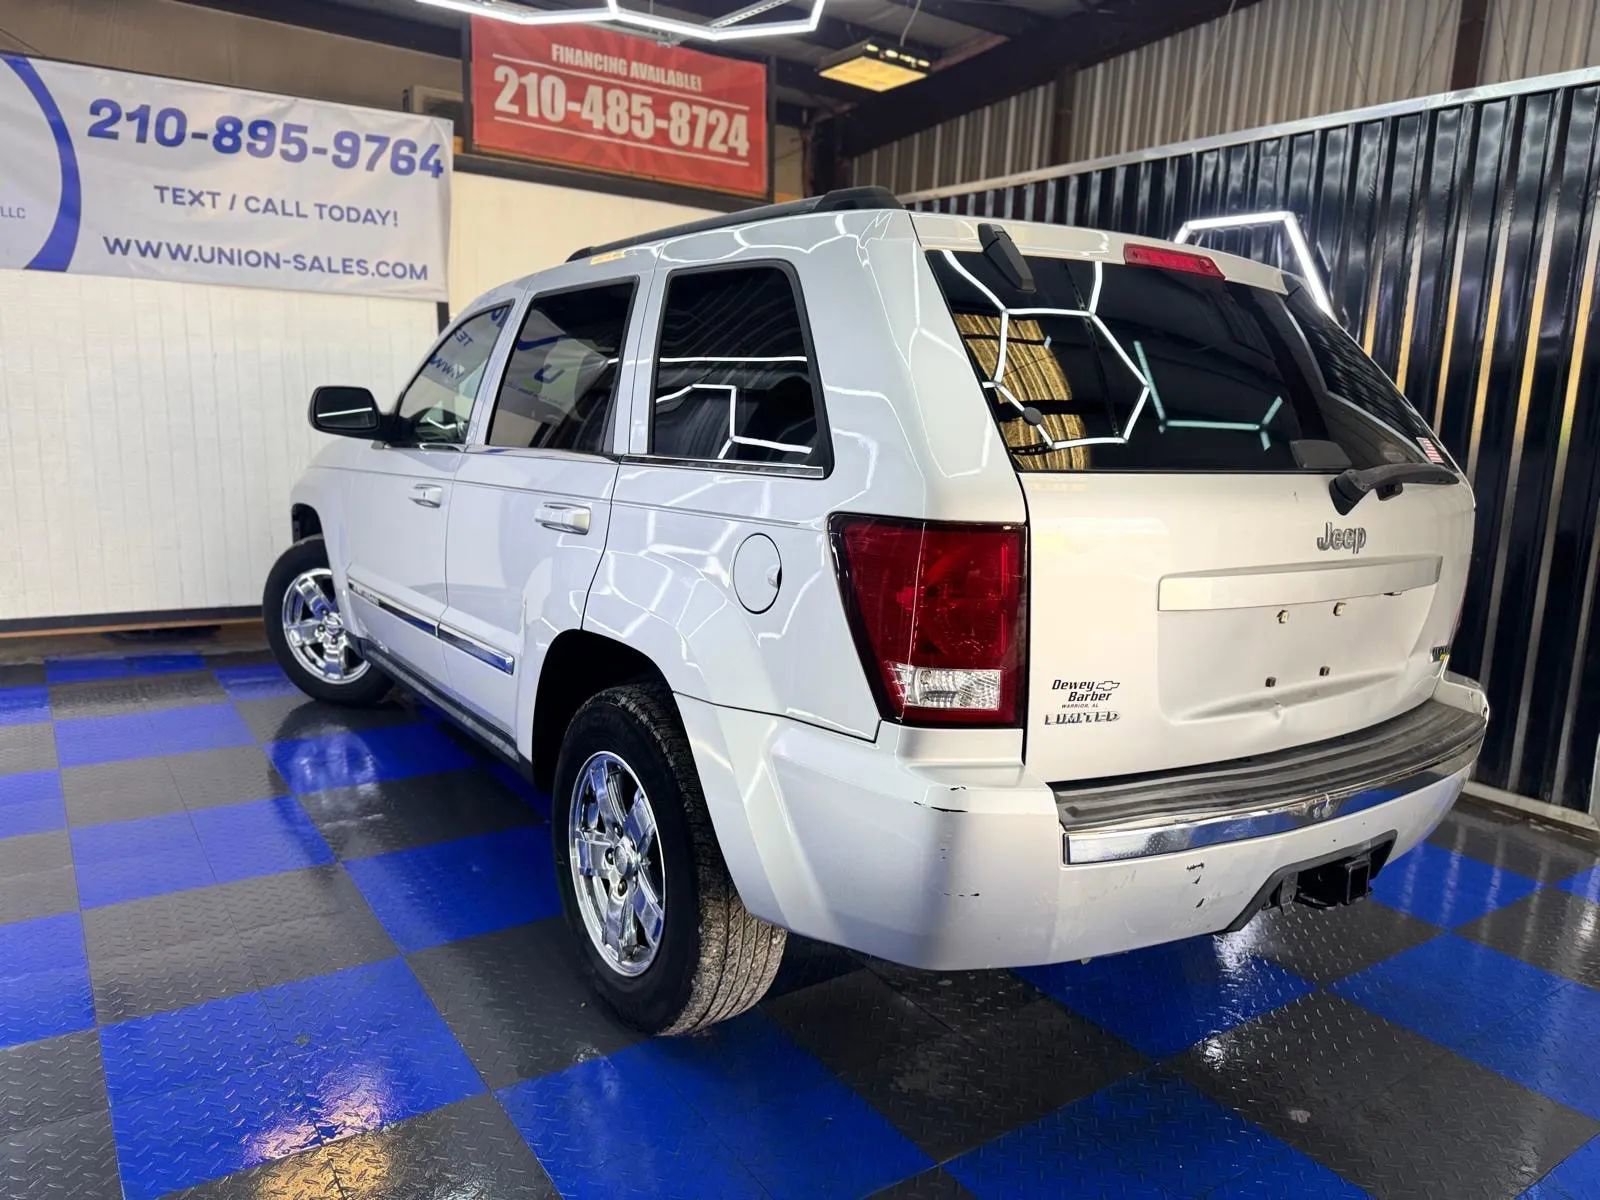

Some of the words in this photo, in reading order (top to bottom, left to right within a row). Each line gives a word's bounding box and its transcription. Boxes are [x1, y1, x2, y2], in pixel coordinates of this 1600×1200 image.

[551, 43, 628, 76] FINANCING
[630, 60, 703, 92] AVAILABLE!
[493, 65, 750, 157] 210-485-8724
[87, 98, 444, 179] 210-895-9764
[153, 184, 221, 211] TEXT
[244, 195, 309, 219] CALL
[314, 202, 400, 227] TODAY!
[102, 235, 428, 281] WWW.UNION-SALES.COM
[1316, 522, 1367, 554] Jeep
[1051, 679, 1096, 692] Dewey
[1068, 691, 1113, 702] Barber
